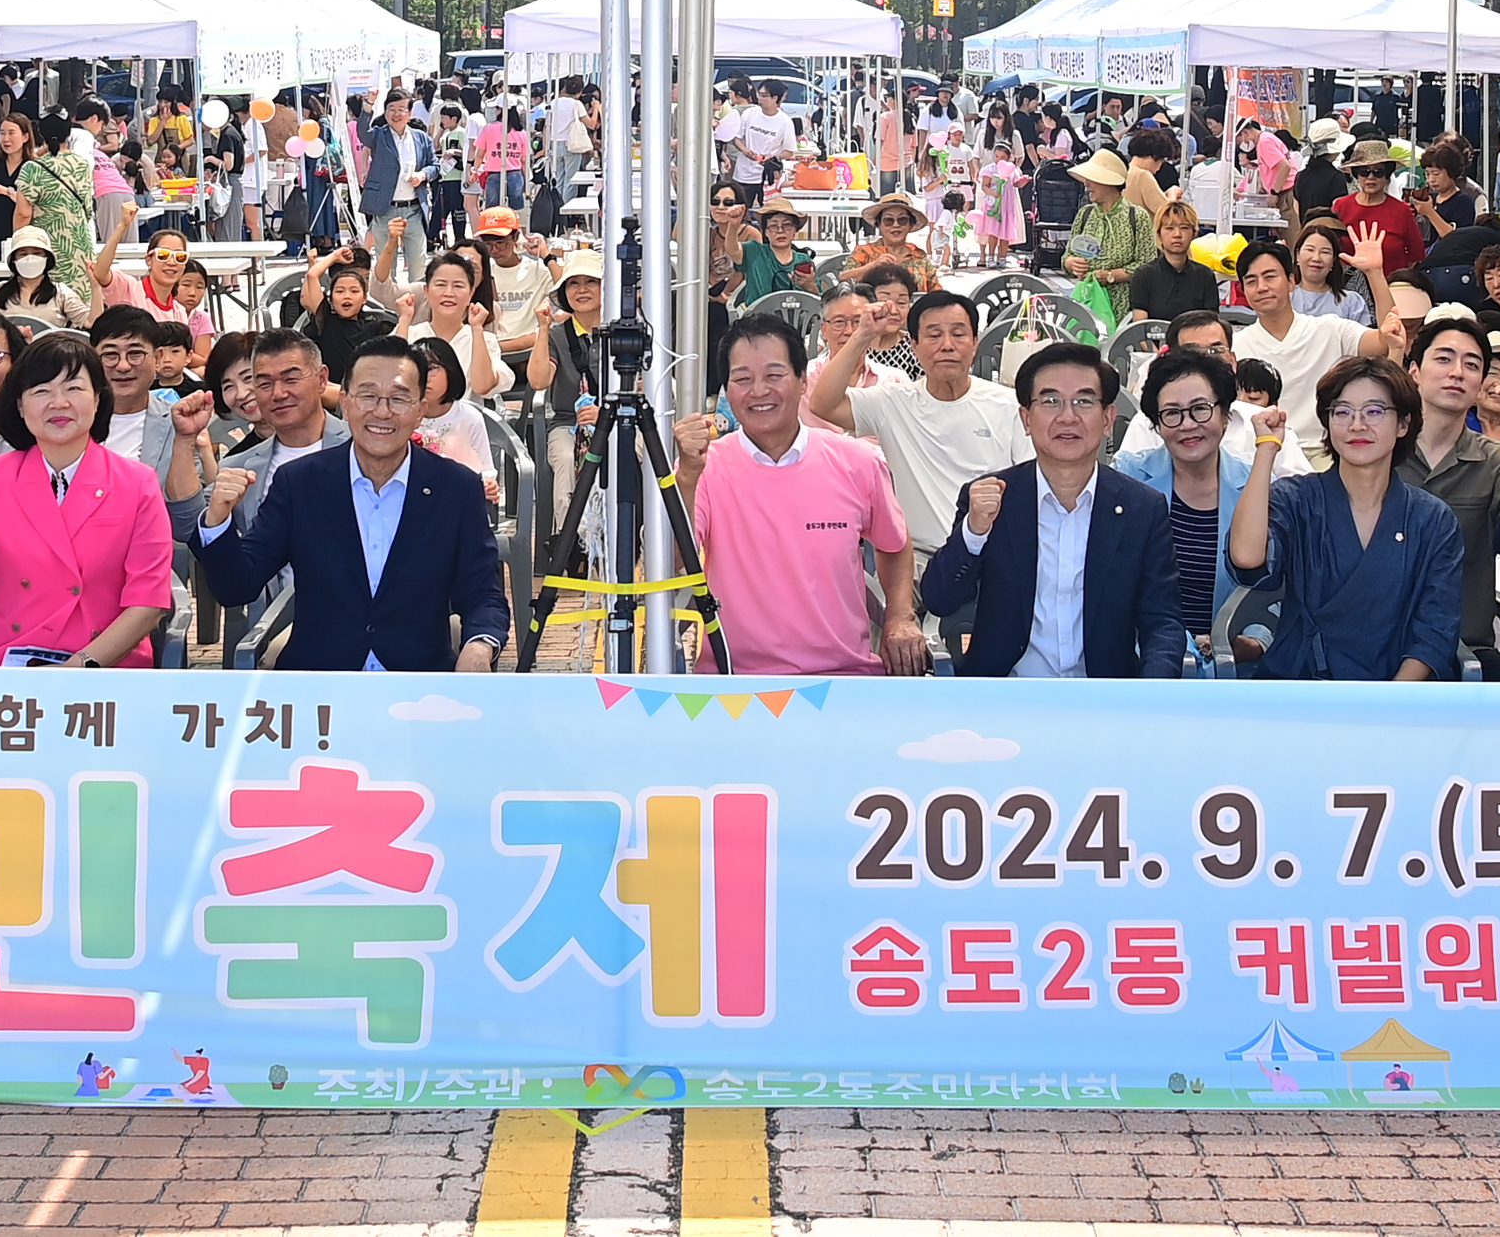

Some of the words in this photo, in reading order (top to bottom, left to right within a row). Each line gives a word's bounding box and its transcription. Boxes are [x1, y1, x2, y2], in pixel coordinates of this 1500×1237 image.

[495, 141, 518, 150] 송2동
[172, 699, 332, 751] 가치!
[853, 793, 1163, 881] 2024.
[1199, 792, 1295, 881] 9.
[850, 925, 1185, 1008] 송도2동
[313, 1066, 524, 1103] 주최/주관
[700, 1068, 1123, 1103] 송도2동주민자치회
